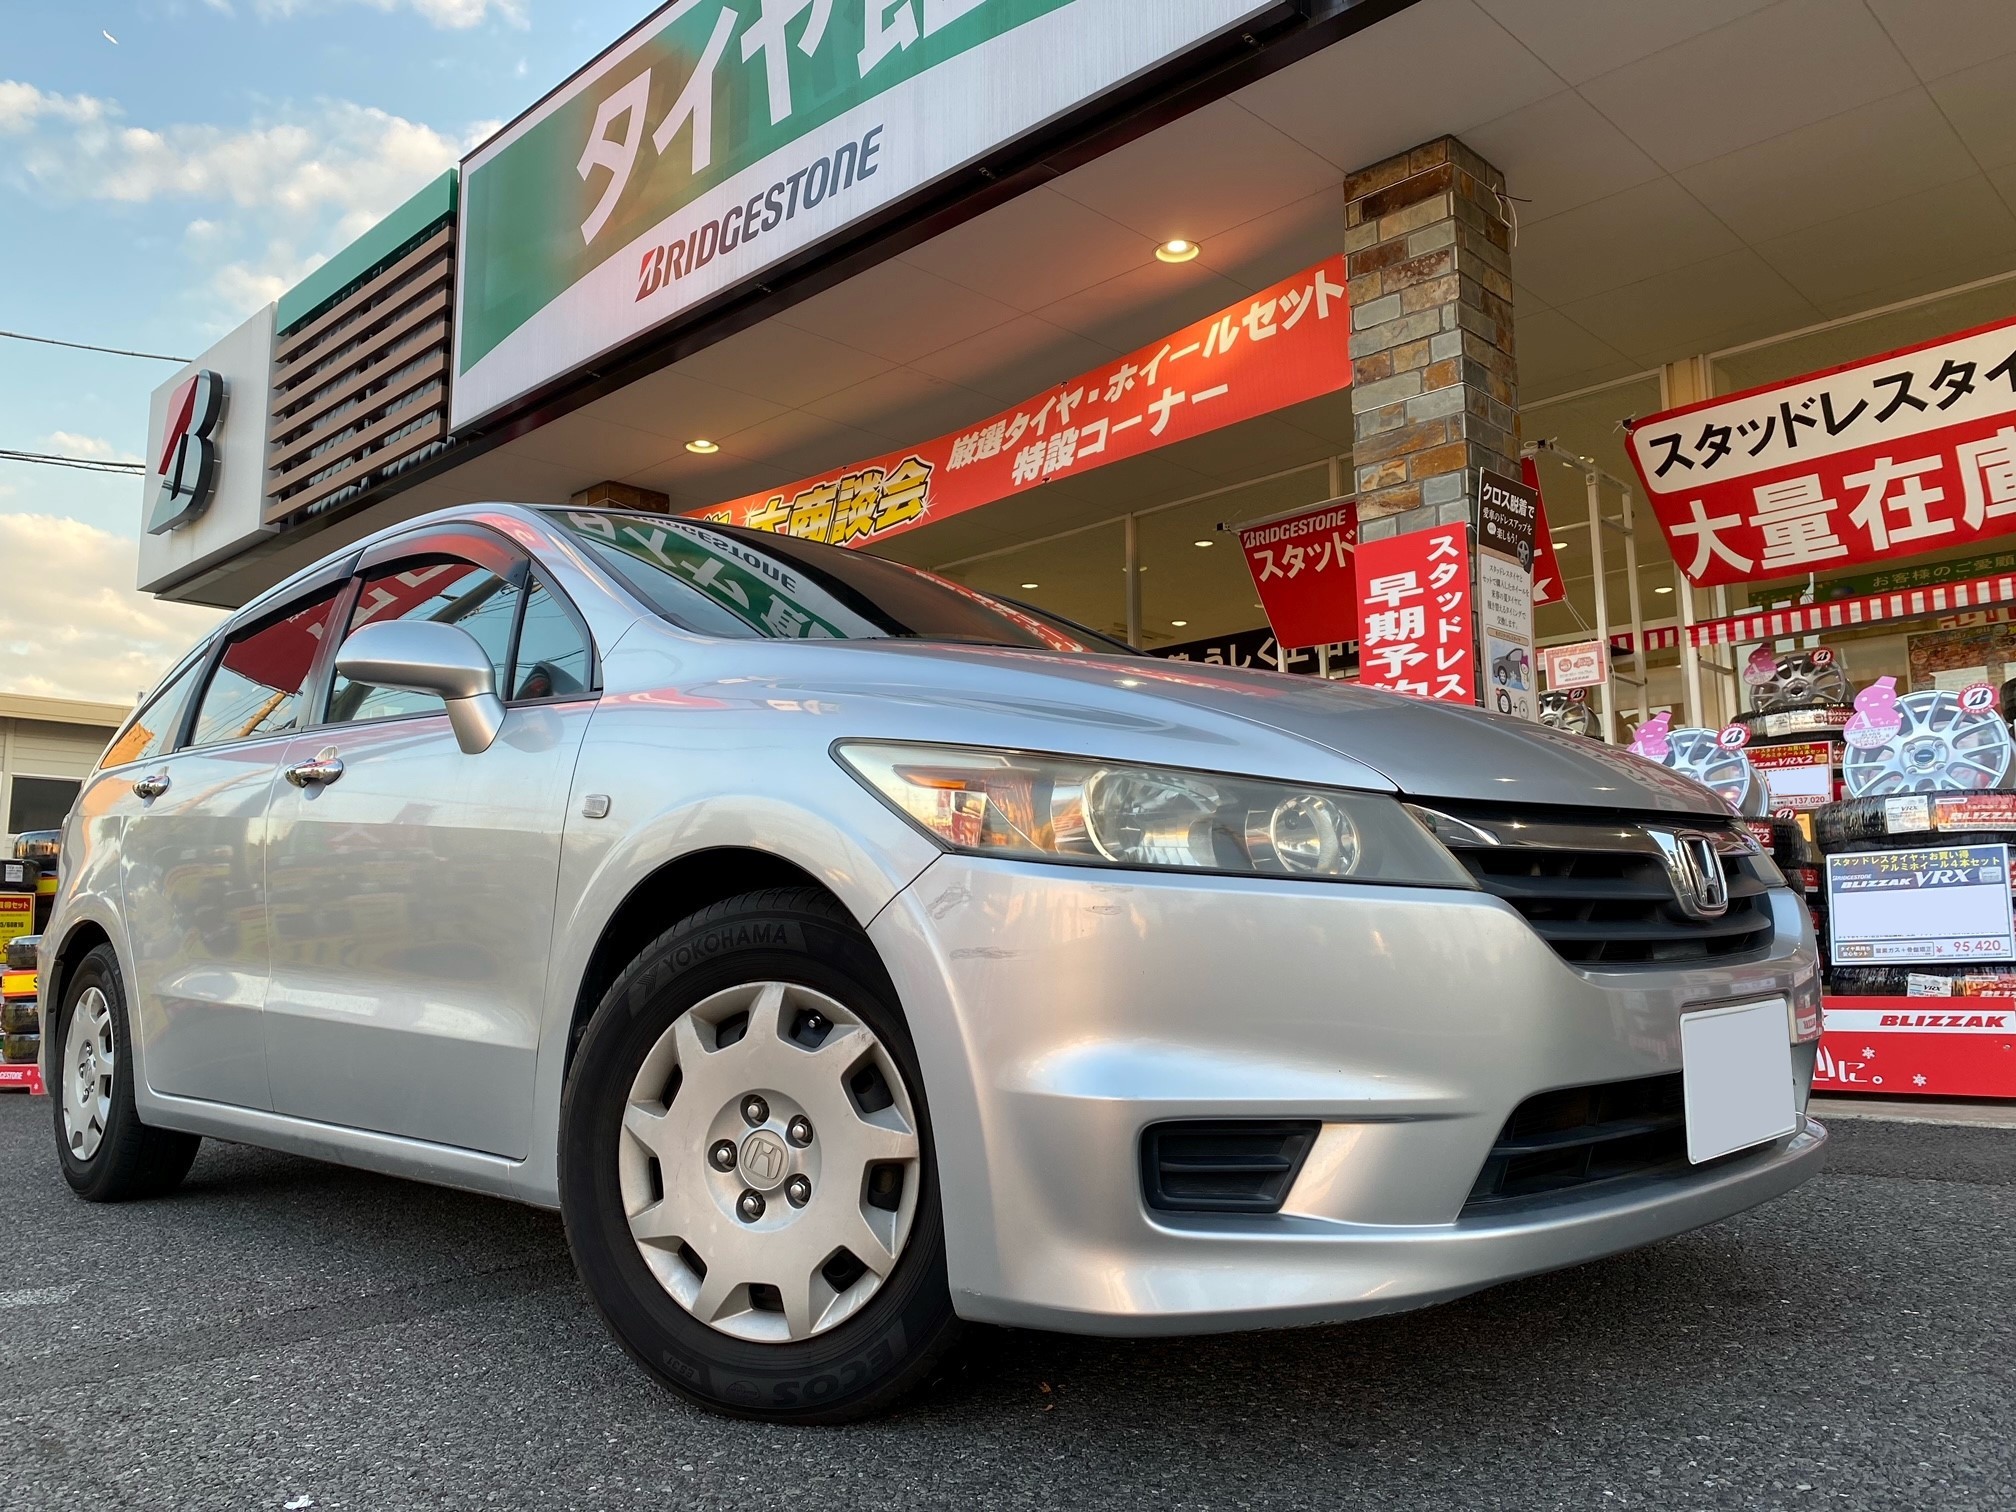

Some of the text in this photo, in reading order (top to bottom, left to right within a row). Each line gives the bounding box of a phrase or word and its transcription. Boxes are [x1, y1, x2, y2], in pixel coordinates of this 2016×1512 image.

[635, 124, 884, 302] BRIDGESTONE
[945, 268, 1346, 473] 厳選タイヤ・ホイールセット
[1011, 382, 1230, 486] 特設コーナー
[1243, 509, 1347, 550] BRIDGESTONE
[1427, 535, 1467, 699] スタッドレス
[1778, 755, 1814, 766] VRX2
[1840, 877, 1913, 889] BLIZZAK
[1913, 868, 1975, 887] VRX
[663, 923, 789, 975] YOKOHAMA
[1953, 940, 2001, 953] 95,420
[1923, 984, 1941, 992] VRX
[1879, 1015, 2008, 1028] BLIZZAK
